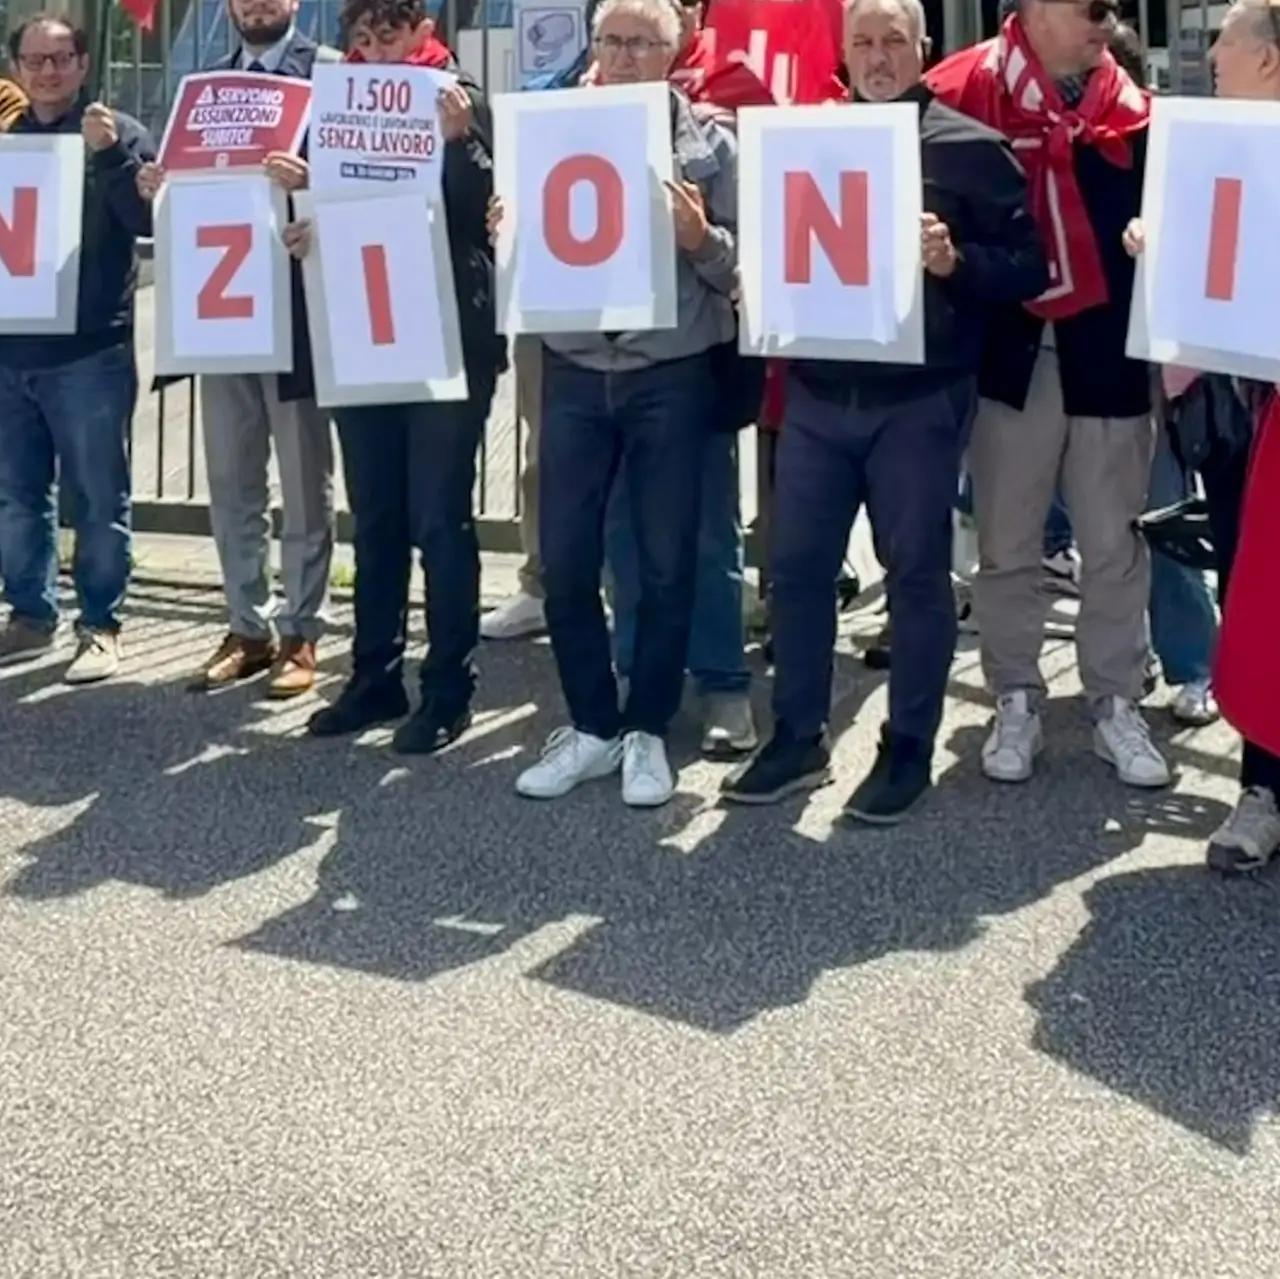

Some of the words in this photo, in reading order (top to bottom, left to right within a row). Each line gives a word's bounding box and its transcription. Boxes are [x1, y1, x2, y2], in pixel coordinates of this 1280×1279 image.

[318, 127, 367, 151] SENZA
[371, 132, 435, 155] LAVORO
[347, 77, 411, 113] 1.500
[542, 154, 624, 266] O
[784, 171, 869, 287] N
[196, 224, 254, 319] Z
